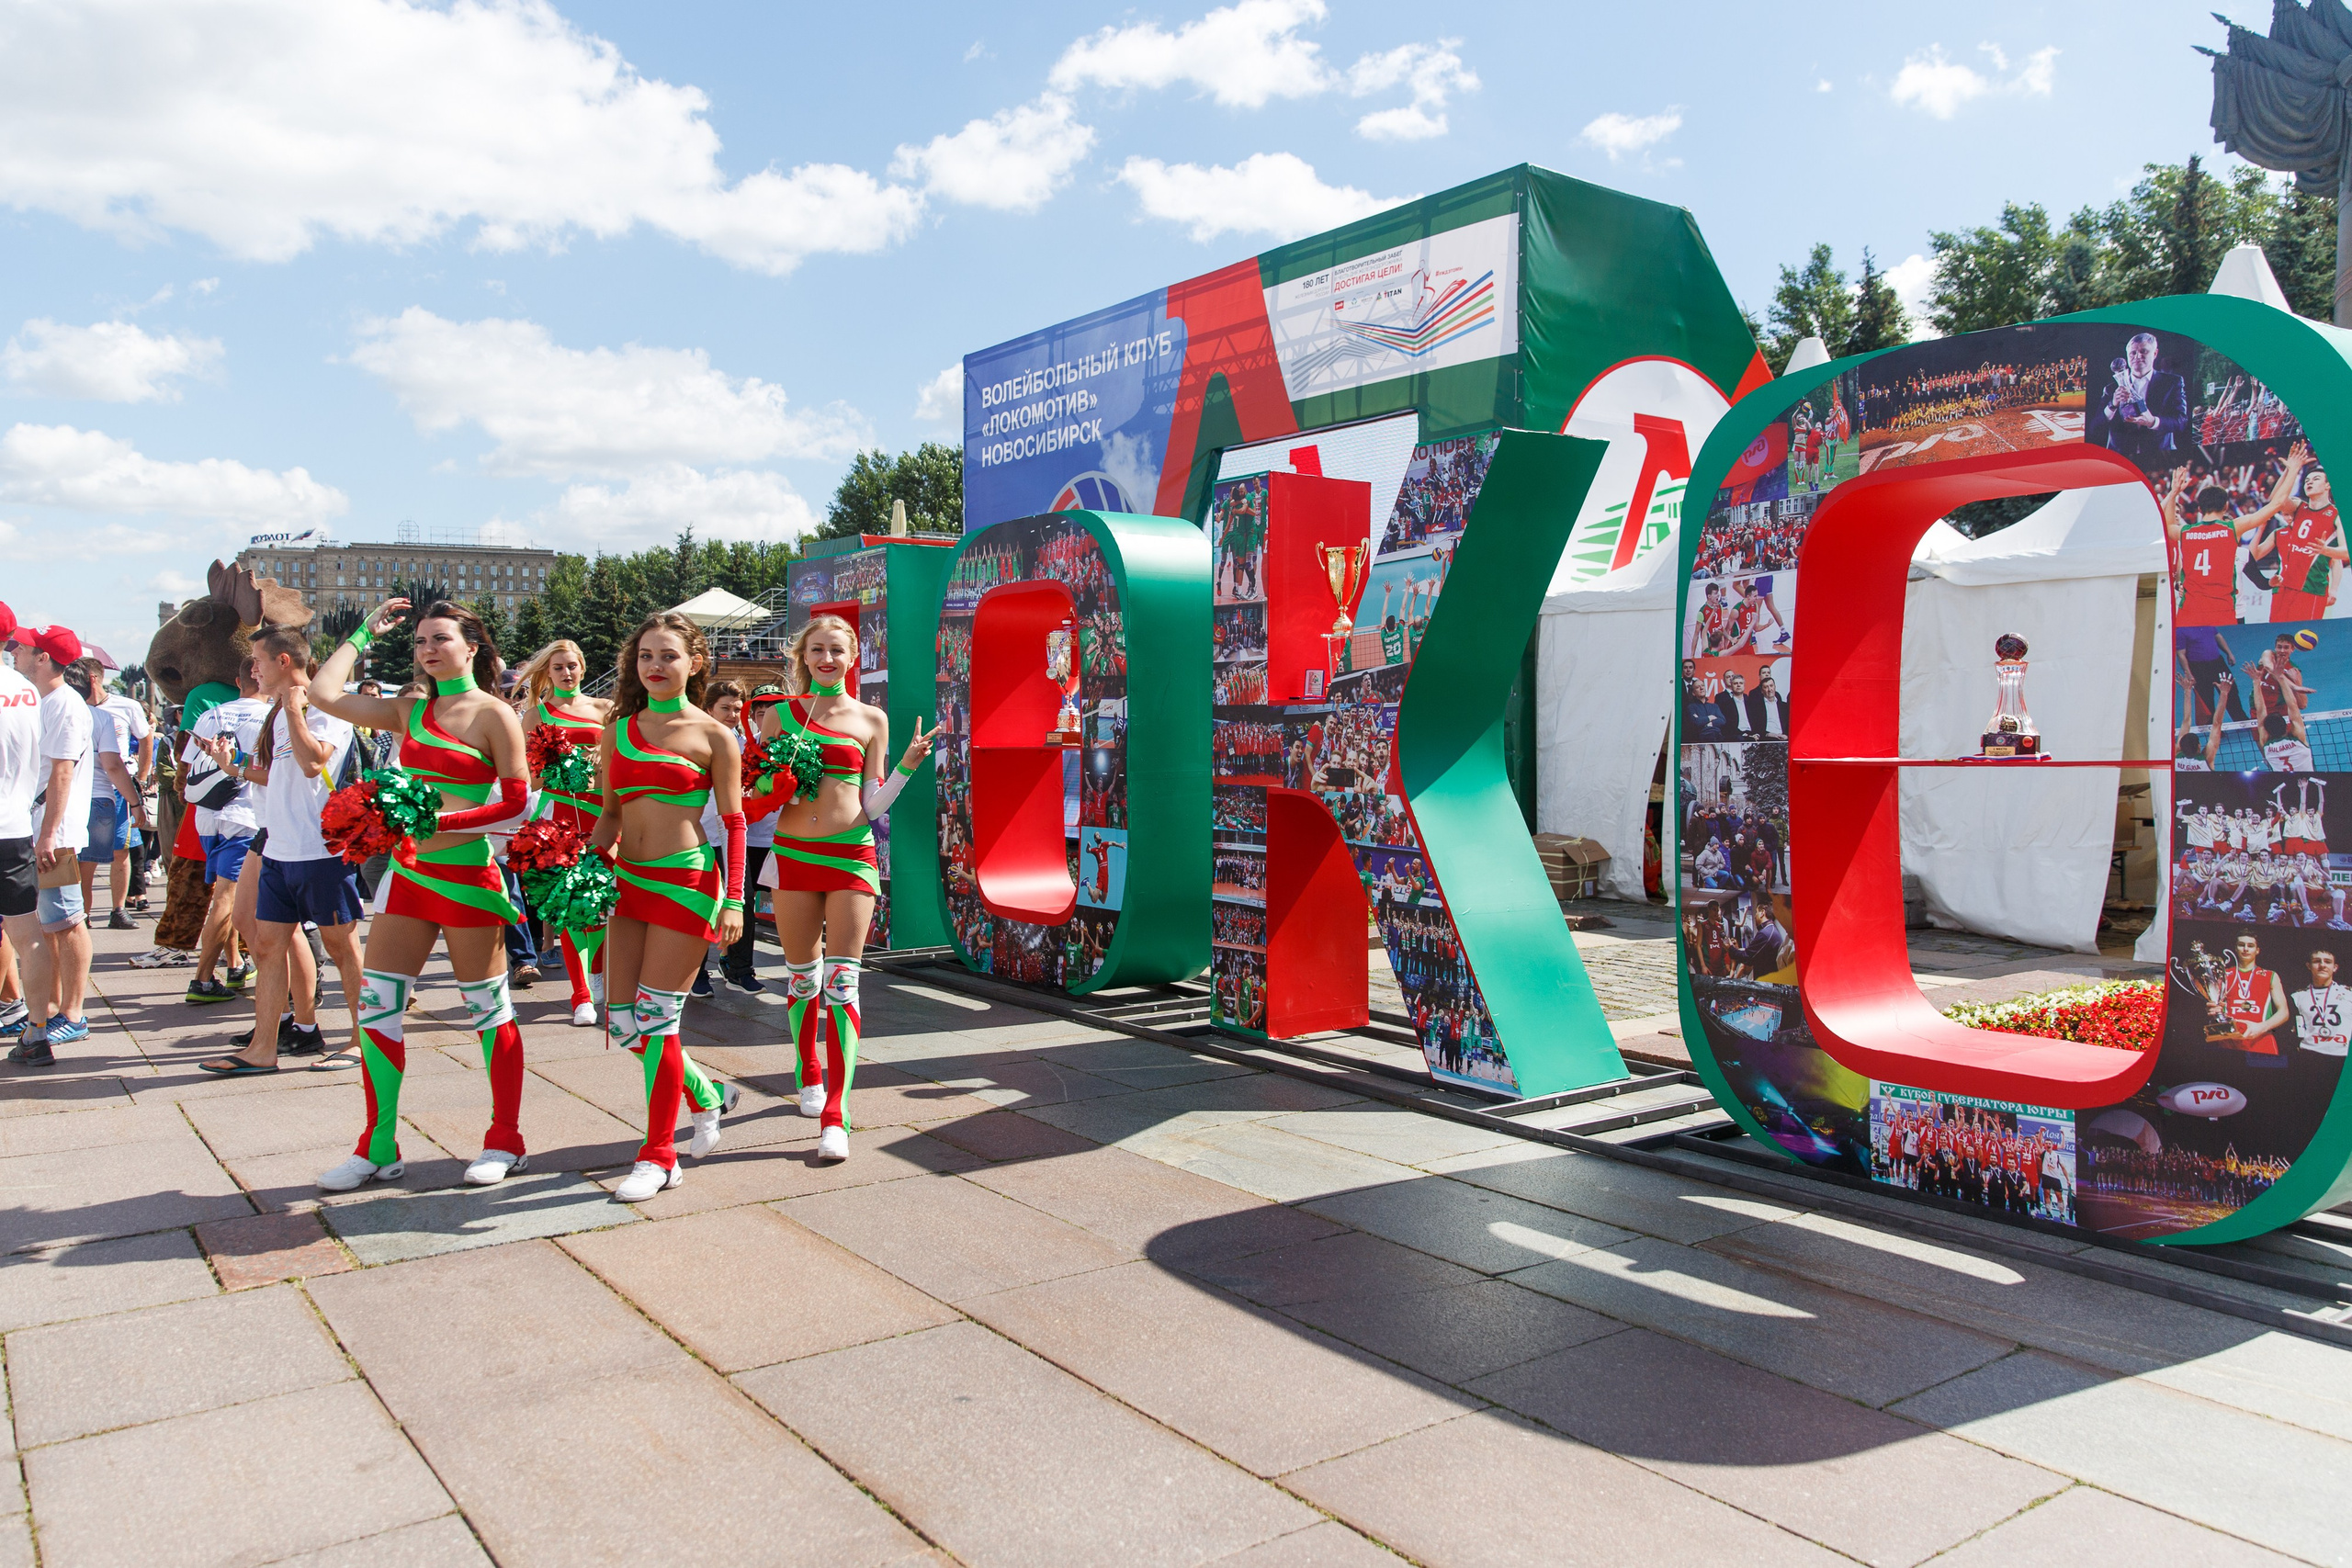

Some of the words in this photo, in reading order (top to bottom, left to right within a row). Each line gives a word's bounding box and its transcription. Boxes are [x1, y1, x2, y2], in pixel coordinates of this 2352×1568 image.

[1334, 254, 1386, 276] БЛАГОТВОРИТЕЛЬНЫЙ
[1387, 250, 1403, 260] ЗАБЕГ
[1302, 279, 1314, 289] 180
[1315, 274, 1329, 286] ЛЕТ
[1334, 272, 1375, 293] ДОСТИГАЯ
[1377, 263, 1403, 279] ЦЕЛИ!
[1384, 288, 1402, 299] TITAN
[981, 343, 1119, 409] ВОЛЕЙБОЛЬНЫЙ
[1124, 331, 1171, 367] КЛУБ
[981, 389, 1098, 437] «ЛОКОМОТИВ»
[981, 418, 1102, 468] НОВОСИБИРСК
[1433, 430, 1501, 457] ПОБЕА
[251, 533, 291, 544] ОФЛОТ
[2185, 529, 2229, 540] НОВОСИБИРСК
[2297, 519, 2312, 539] 6
[2193, 548, 2211, 577] 4
[1746, 612, 1751, 625] 9
[1385, 641, 1402, 658] 20
[2267, 742, 2297, 753] BULGARIA
[2278, 756, 2294, 773] 3
[2310, 1004, 2342, 1026] 23
[1938, 1092, 2024, 1114] ГУБЕРНАТОРА
[2026, 1103, 2068, 1120] ЮГРЫ
[2190, 1087, 2230, 1105] РЖД
